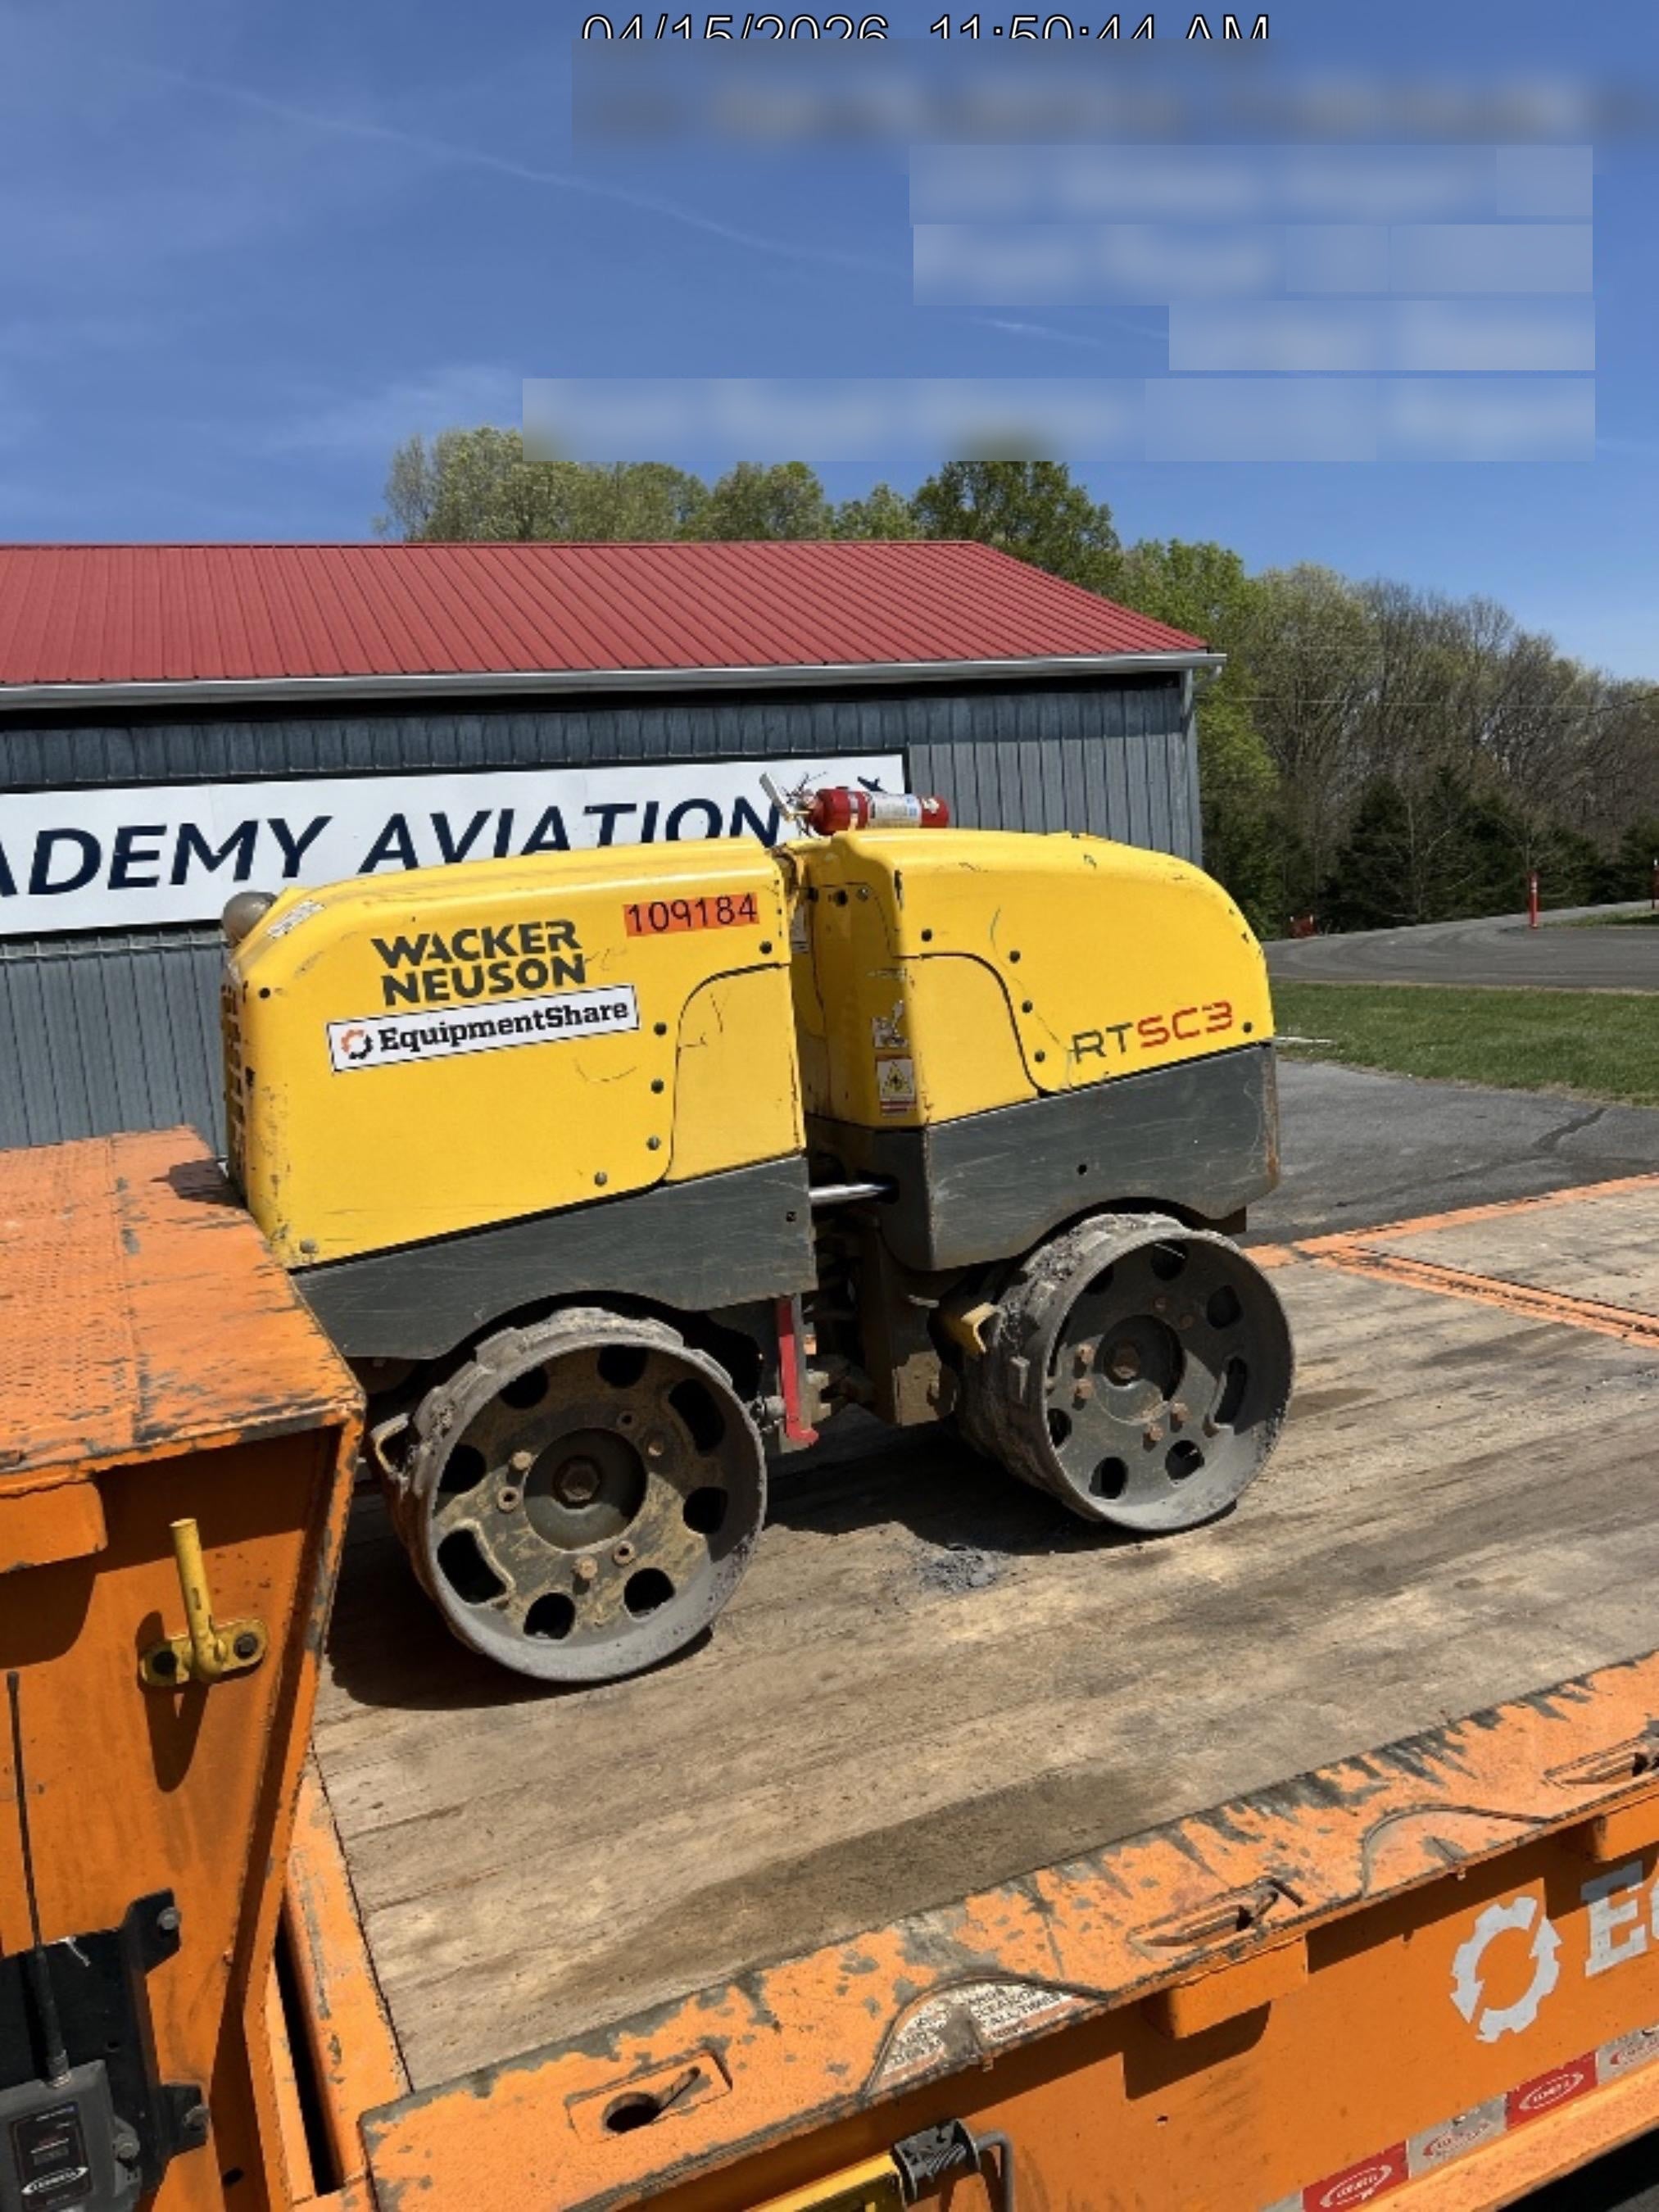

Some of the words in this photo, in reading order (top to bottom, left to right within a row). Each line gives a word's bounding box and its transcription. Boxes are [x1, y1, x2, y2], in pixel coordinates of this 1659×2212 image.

[0, 816, 333, 896] DEMY
[356, 796, 781, 874] AVIATION
[628, 893, 756, 932] 109184
[371, 919, 582, 968] WACKER
[381, 954, 586, 1006] NEUSON
[378, 999, 629, 1054] EquipmentShare
[1071, 1000, 1233, 1064] RTSC3
